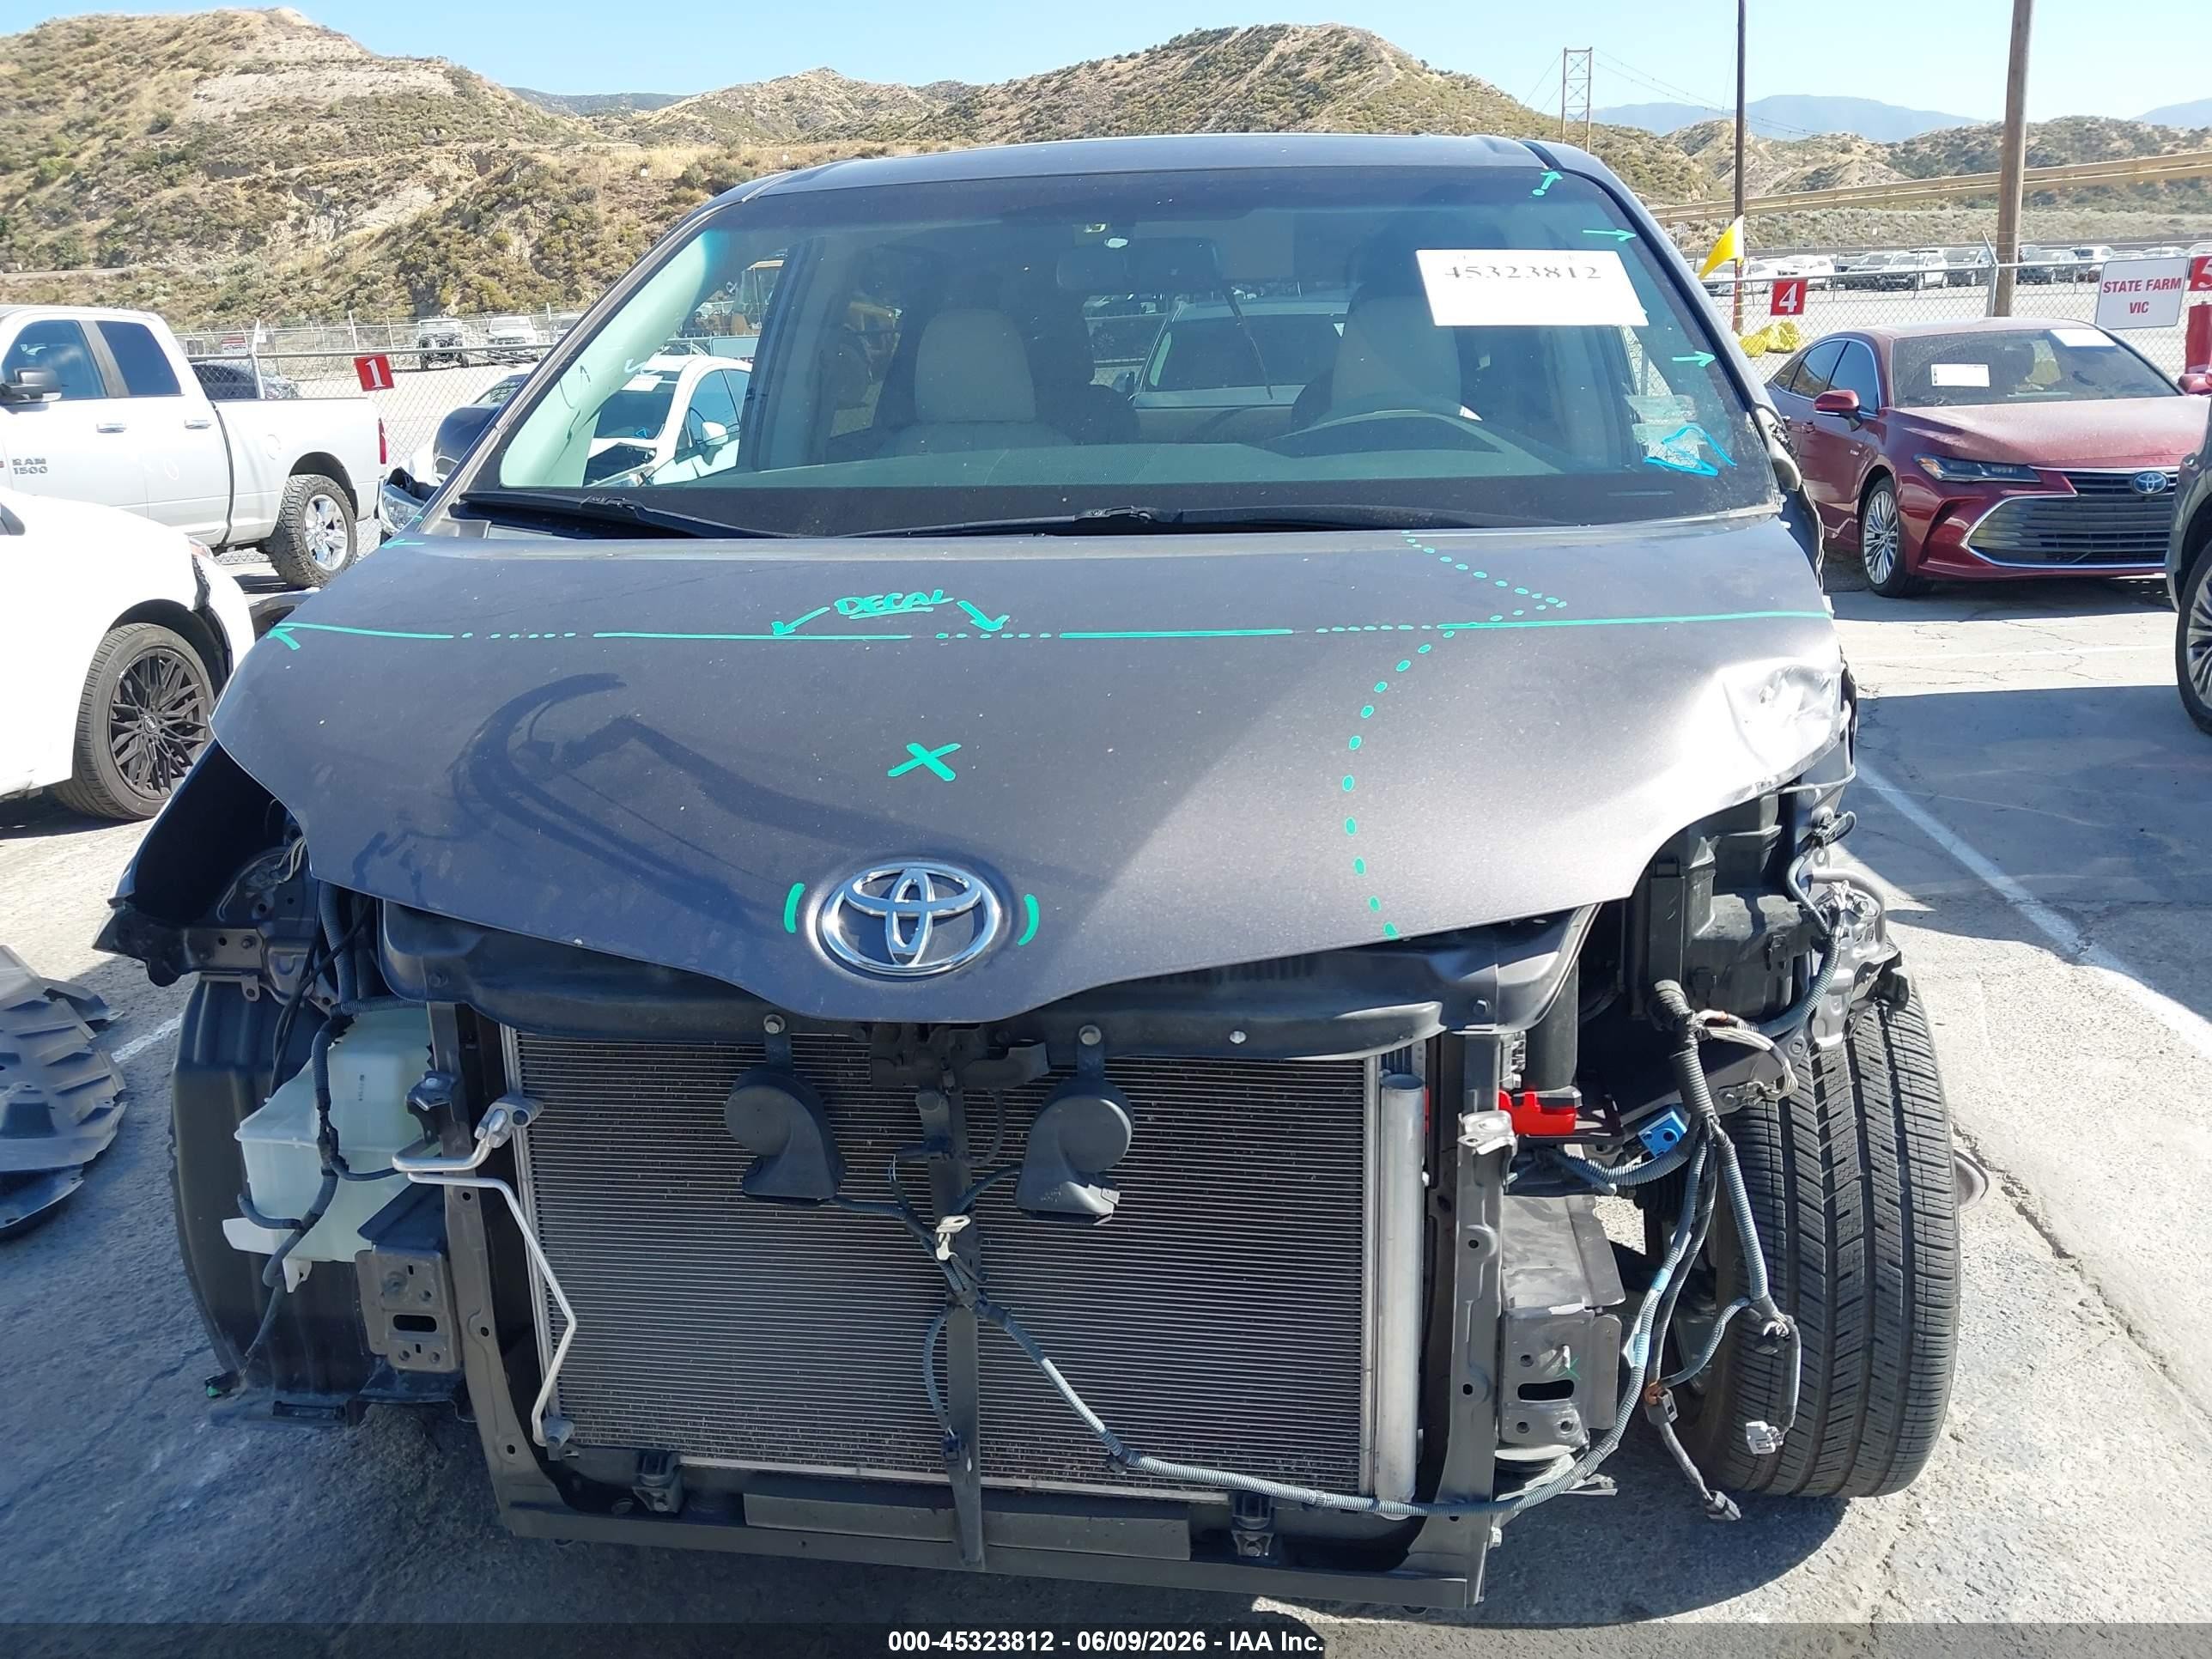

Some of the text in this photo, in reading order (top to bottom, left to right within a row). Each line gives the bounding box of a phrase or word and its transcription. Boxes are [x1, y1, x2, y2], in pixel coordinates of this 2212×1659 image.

[1444, 265, 1601, 279] 45323812
[2102, 277, 2183, 294] STATE FARM
[1778, 283, 1798, 313] 4
[2130, 301, 2149, 314] VIC
[365, 358, 386, 388] 1
[13, 465, 48, 475] 1500
[834, 589, 955, 617] DECAL
